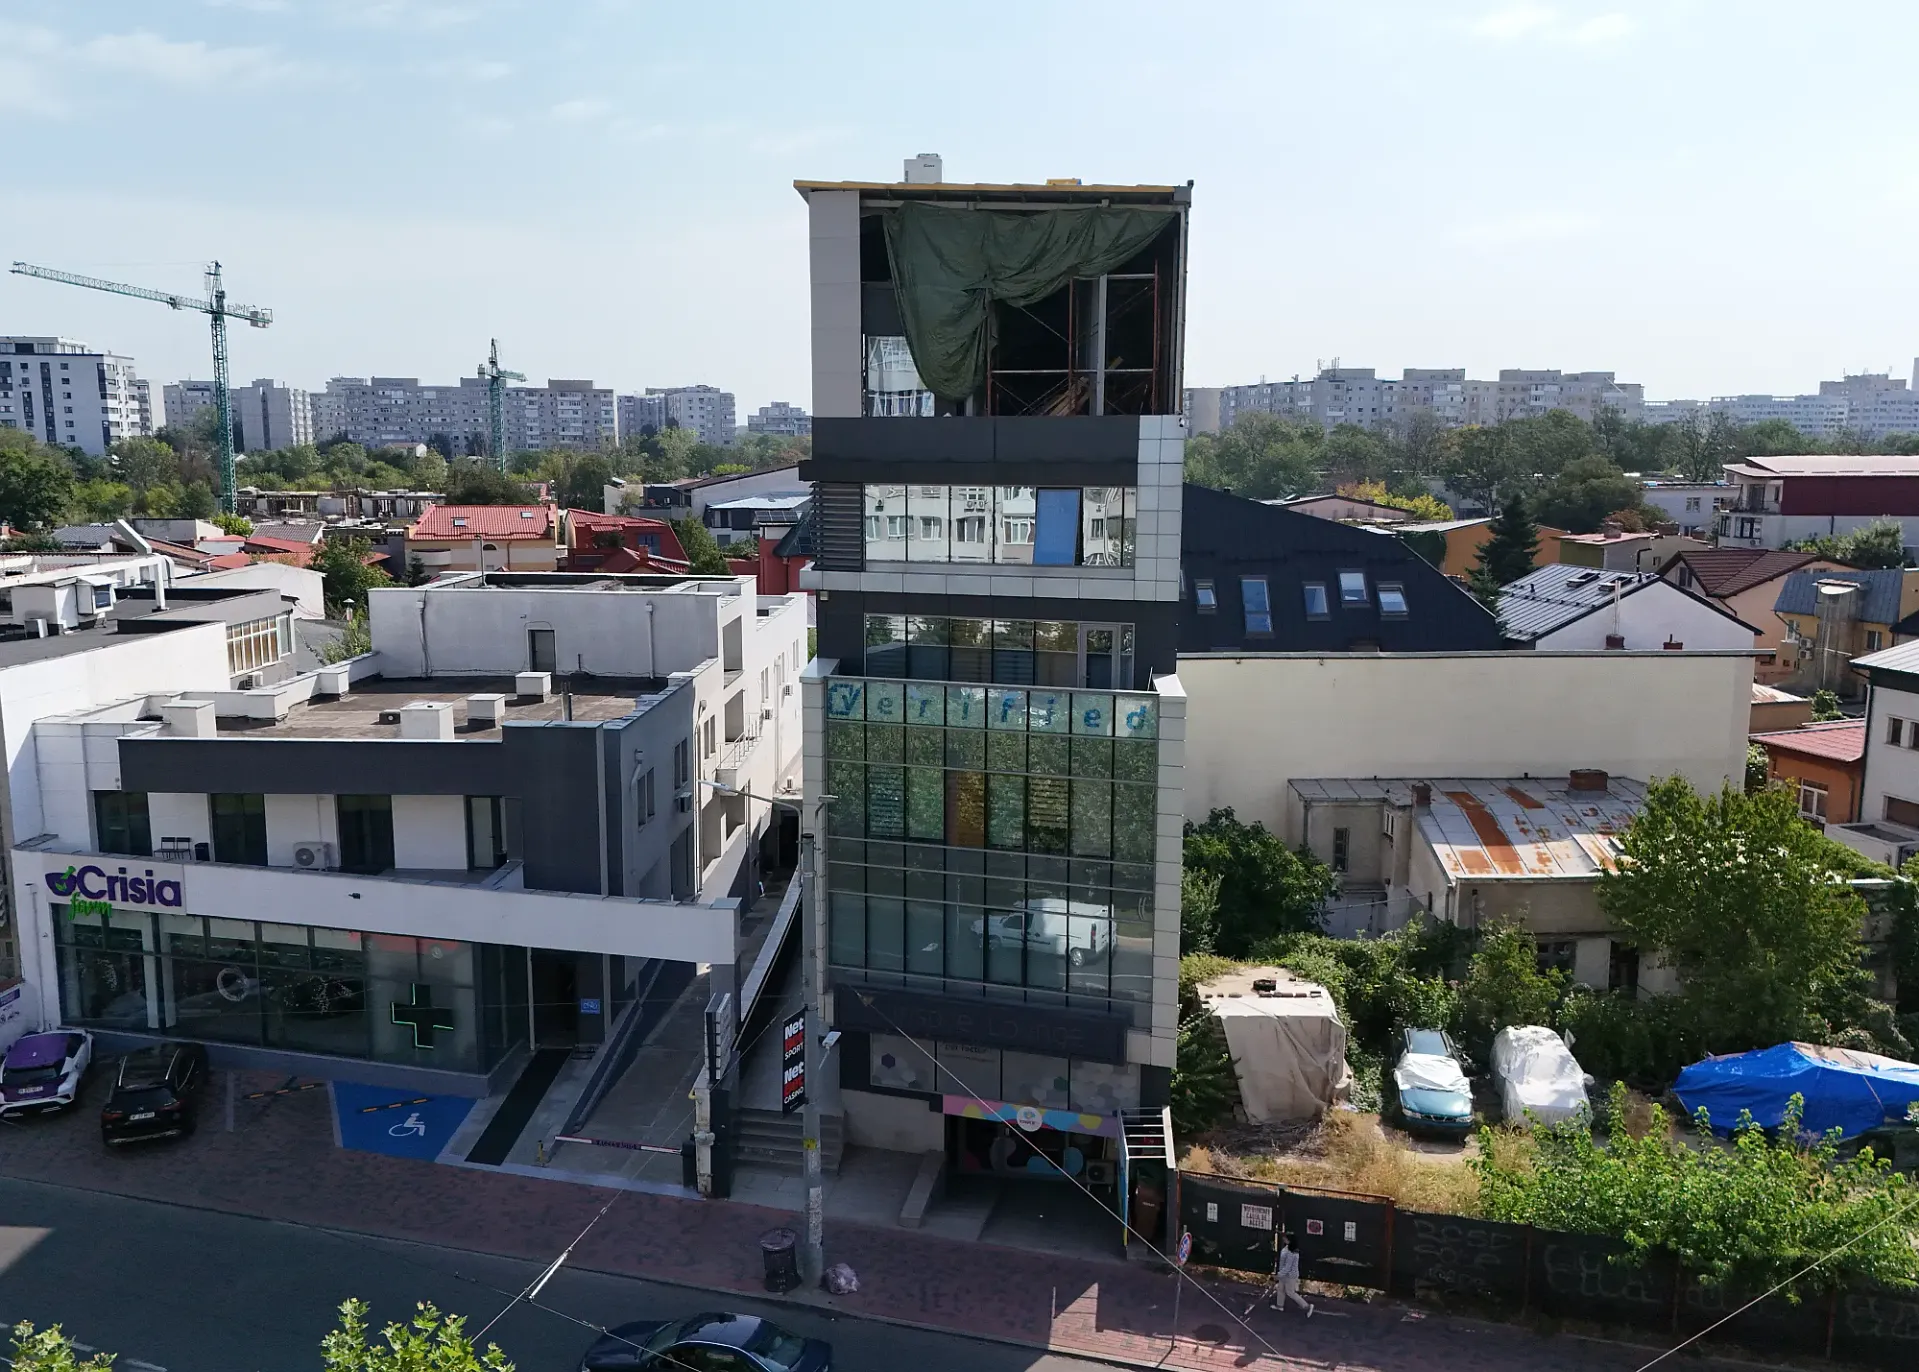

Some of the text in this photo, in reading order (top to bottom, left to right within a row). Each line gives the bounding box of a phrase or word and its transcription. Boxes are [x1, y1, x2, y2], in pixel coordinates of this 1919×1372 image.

[76, 865, 182, 907] Crisia
[784, 1017, 804, 1040] Net
[784, 1041, 804, 1061] SPORT
[784, 1061, 805, 1084] Net
[783, 1086, 804, 1104] CASINO
